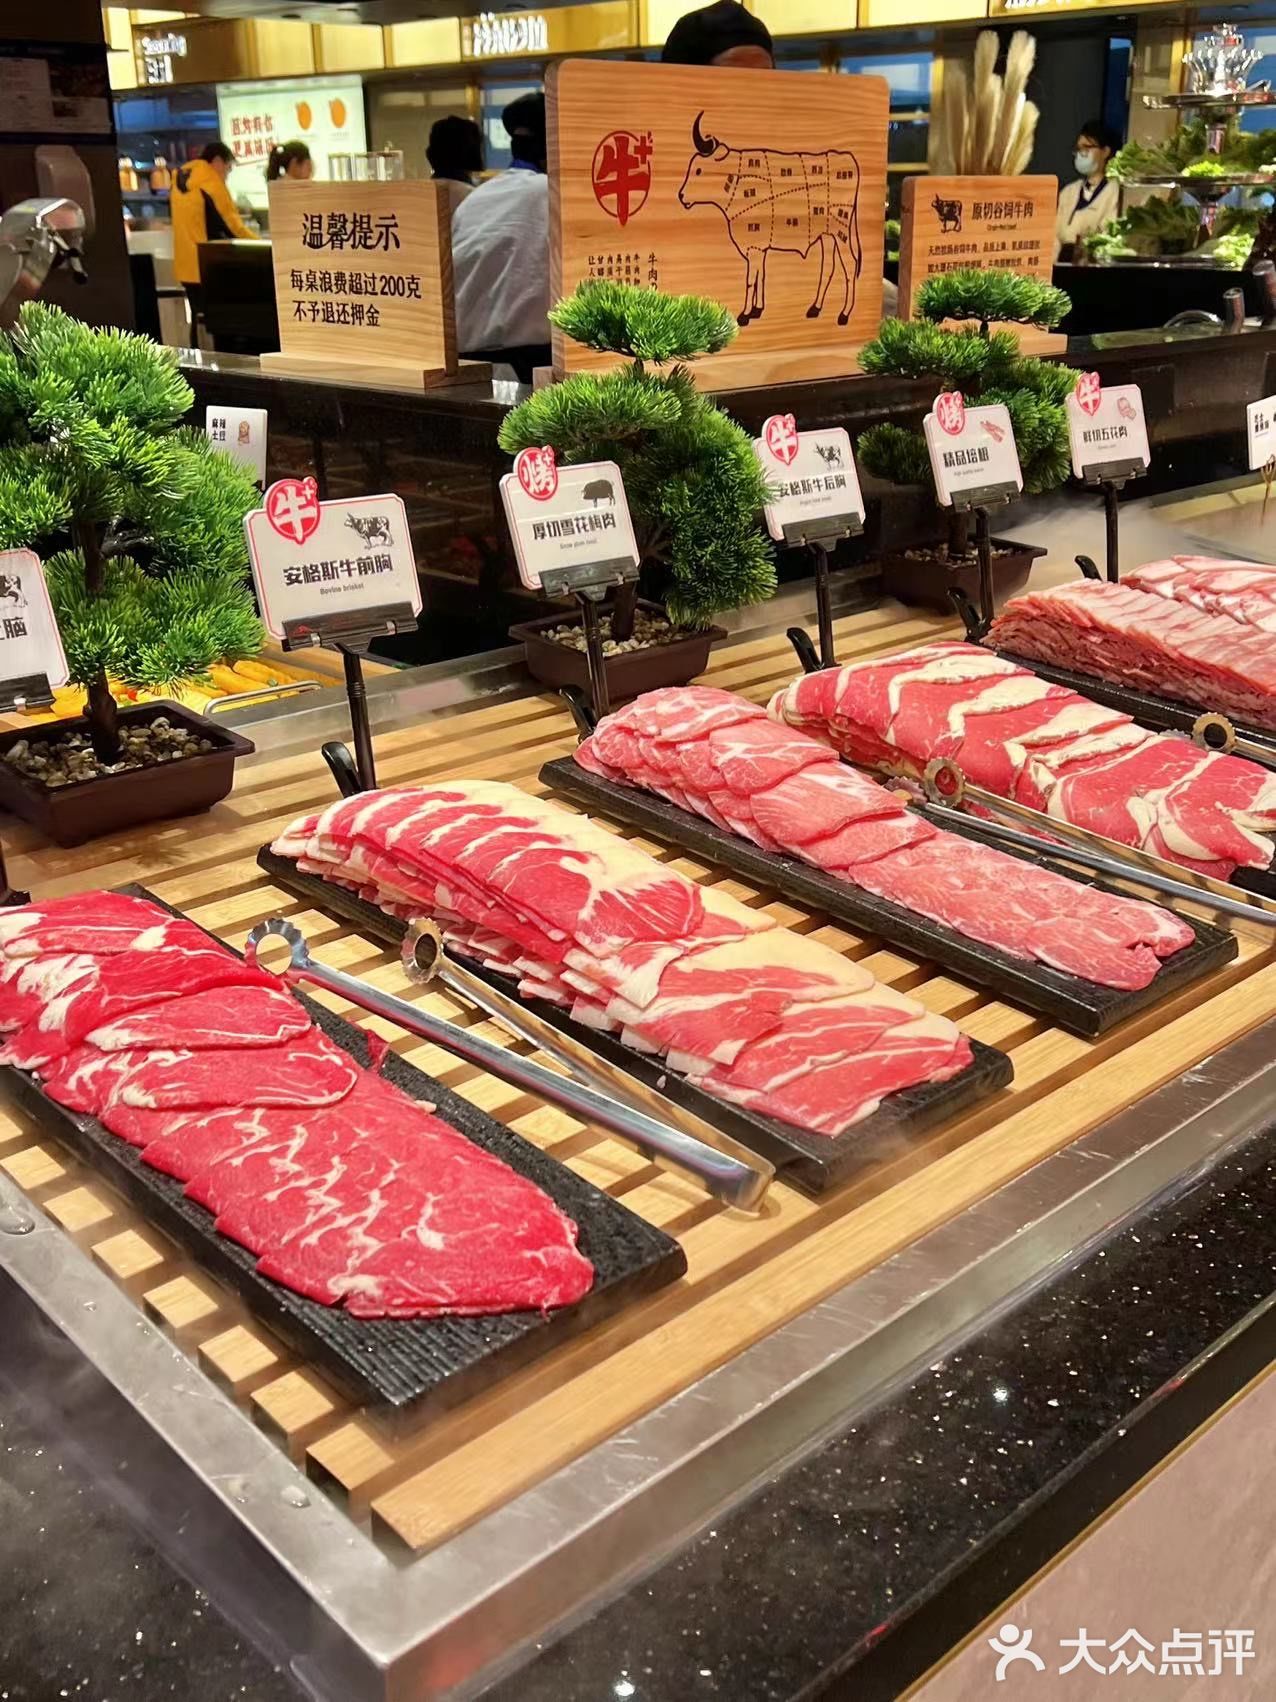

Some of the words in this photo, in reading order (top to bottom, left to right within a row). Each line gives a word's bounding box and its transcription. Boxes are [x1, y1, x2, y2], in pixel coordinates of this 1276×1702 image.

[972, 201, 1034, 220] 原切谷饲牛肉
[302, 212, 400, 251] 温馨提示
[290, 269, 422, 299] 每桌浪费超过200克
[292, 300, 381, 327] 不予退还押金
[943, 447, 989, 468] 精品培根
[779, 475, 847, 497] 安格斯牛后胸
[532, 513, 616, 540] 厚切雪花梅肉
[283, 554, 393, 586] 安格斯牛前胸
[320, 586, 342, 595] Bovine
[343, 583, 364, 593] brisket
